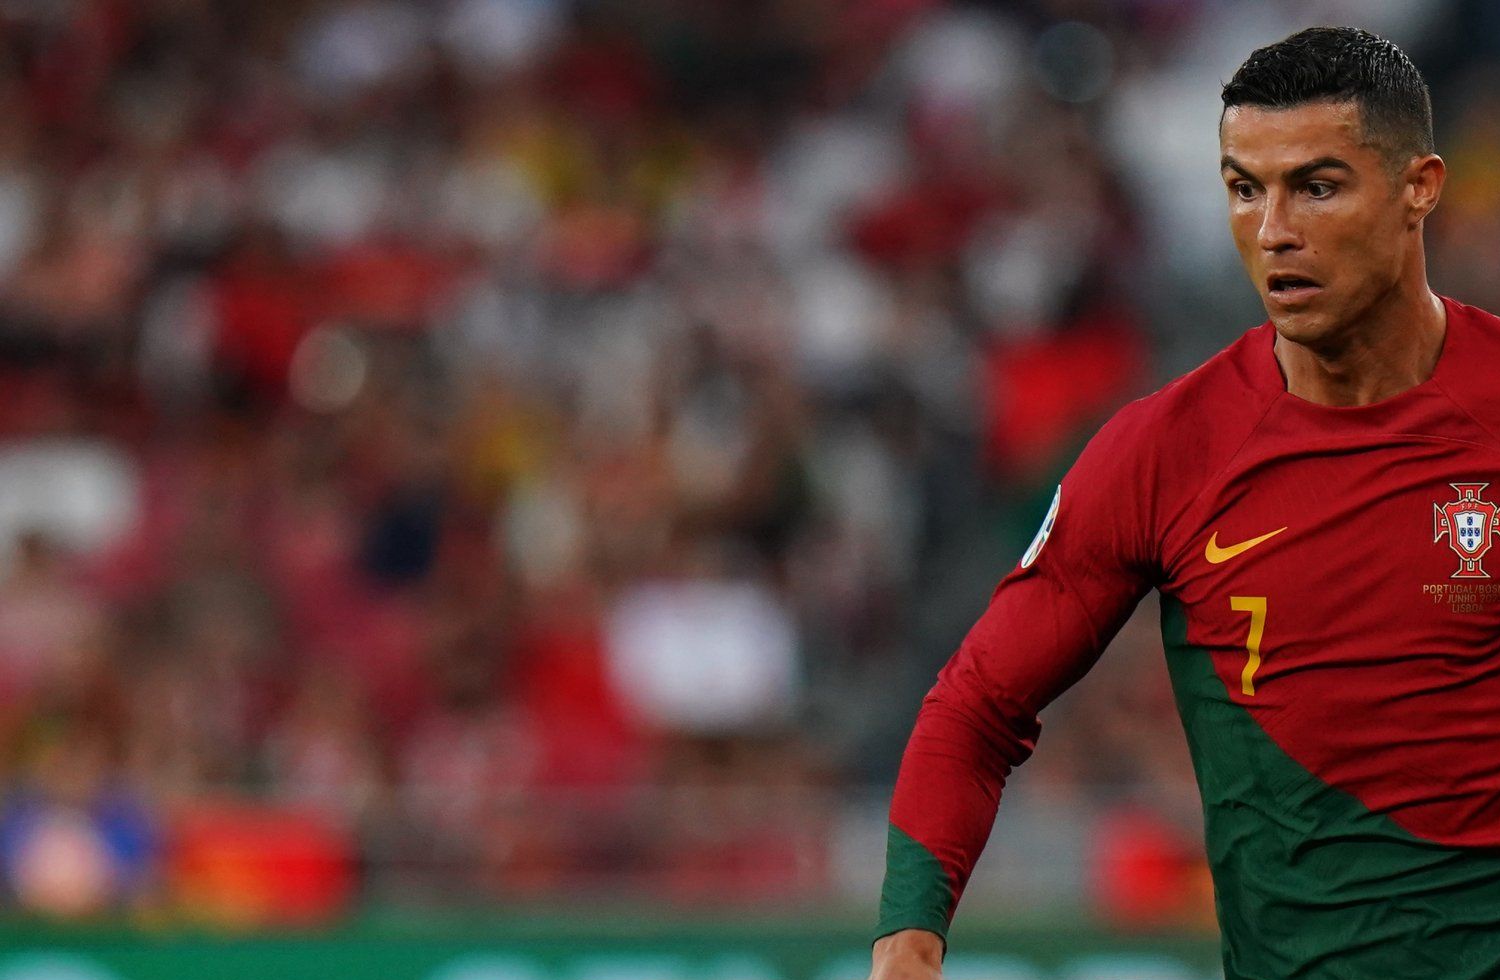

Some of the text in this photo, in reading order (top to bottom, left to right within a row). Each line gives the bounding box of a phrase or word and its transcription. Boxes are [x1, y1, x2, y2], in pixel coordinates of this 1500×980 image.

[1434, 594, 1443, 603] 17
[1447, 594, 1477, 603] JUNHO
[1230, 597, 1267, 696] 7
